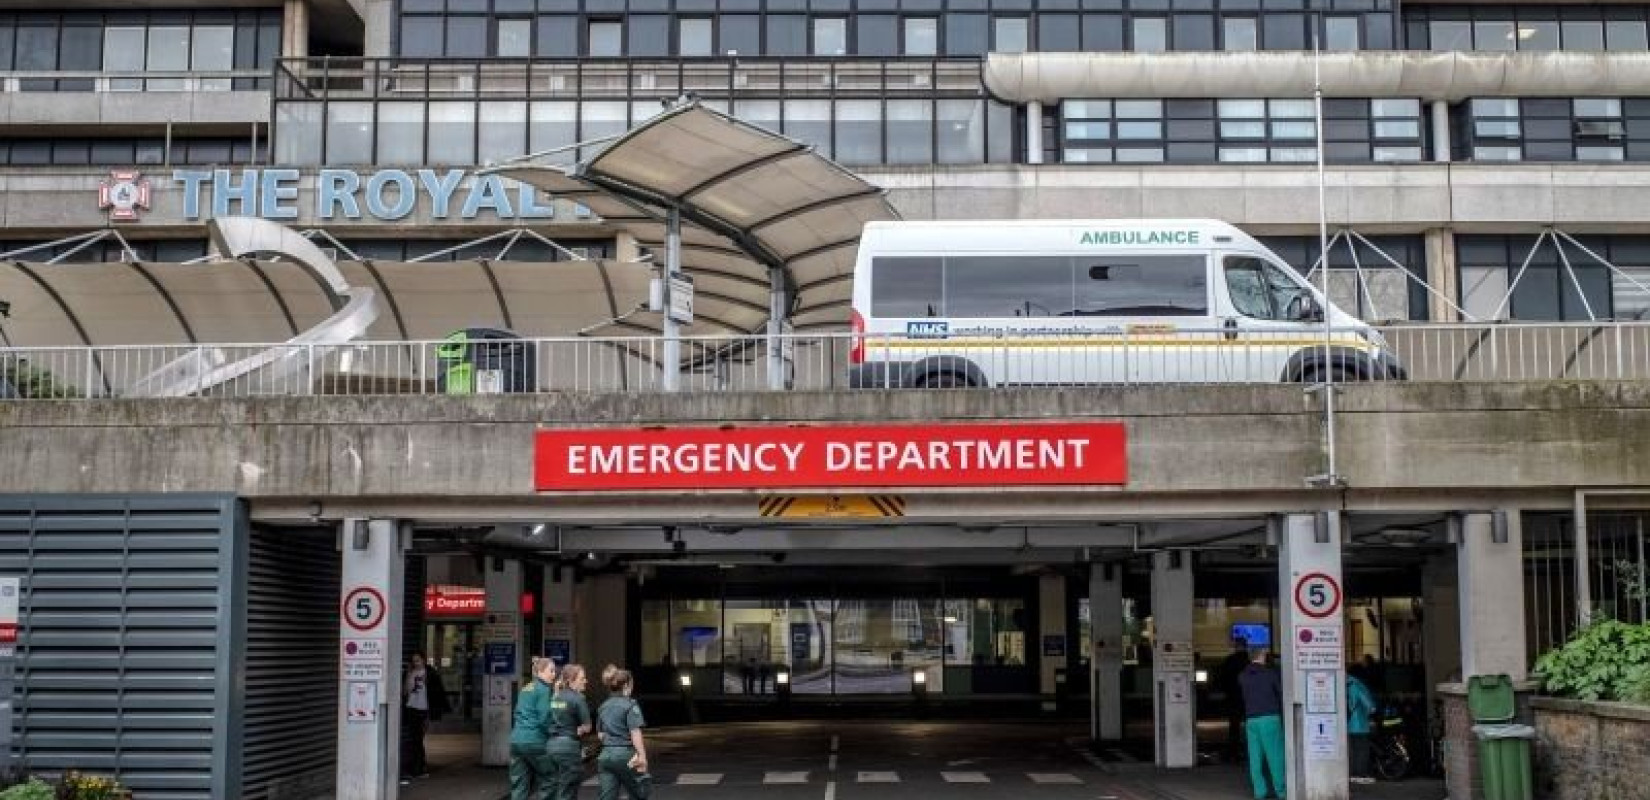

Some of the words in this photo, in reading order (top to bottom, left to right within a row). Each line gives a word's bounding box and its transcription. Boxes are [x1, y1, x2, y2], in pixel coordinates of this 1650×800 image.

[172, 168, 298, 218] THE
[319, 168, 553, 218] ROYAL
[1079, 230, 1200, 245] AMBULANCE
[909, 322, 946, 336] NHS
[953, 325, 1003, 339] working
[567, 442, 805, 475] EMERGENCY
[825, 438, 1091, 472] DEPARTMENT
[1309, 583, 1327, 608] 5
[356, 598, 372, 620] 5
